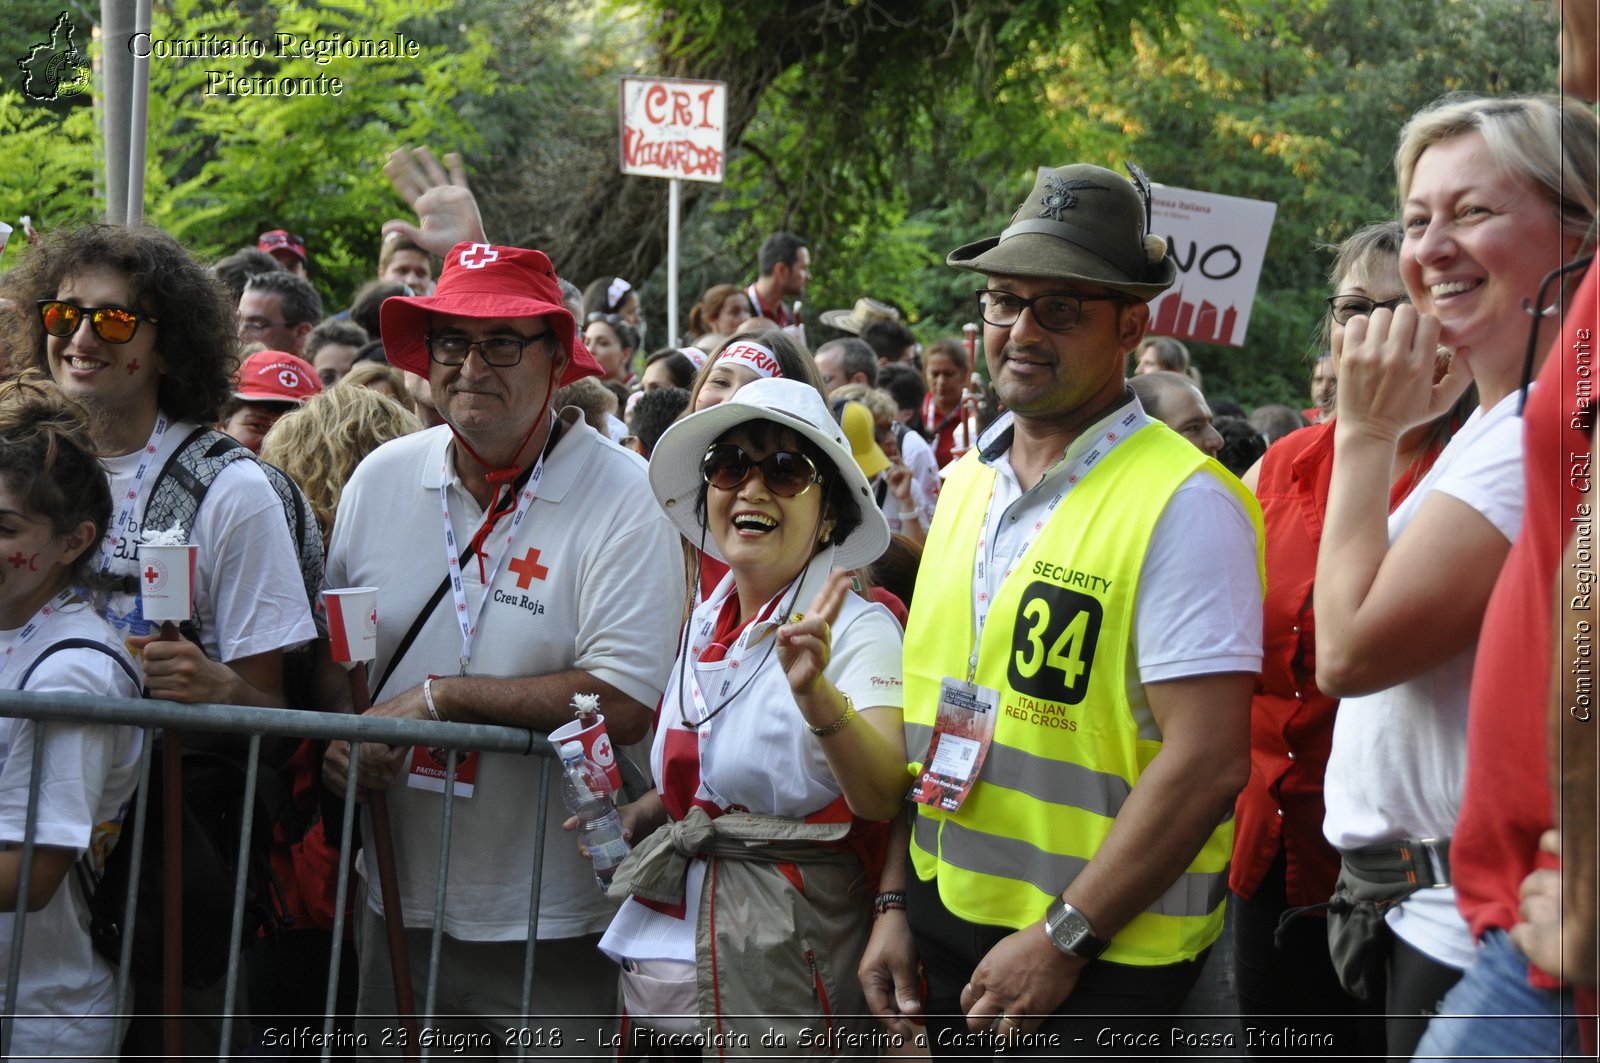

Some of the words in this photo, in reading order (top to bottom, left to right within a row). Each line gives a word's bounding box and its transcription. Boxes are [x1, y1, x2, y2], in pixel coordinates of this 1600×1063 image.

[1032, 560, 1112, 594] SECURITY
[494, 589, 518, 606] Creu
[519, 594, 545, 616] Roja
[1015, 597, 1090, 689] 34
[1005, 705, 1028, 722] RED
[1031, 712, 1077, 732] CROSS
[1018, 696, 1066, 717] ITALIAN
